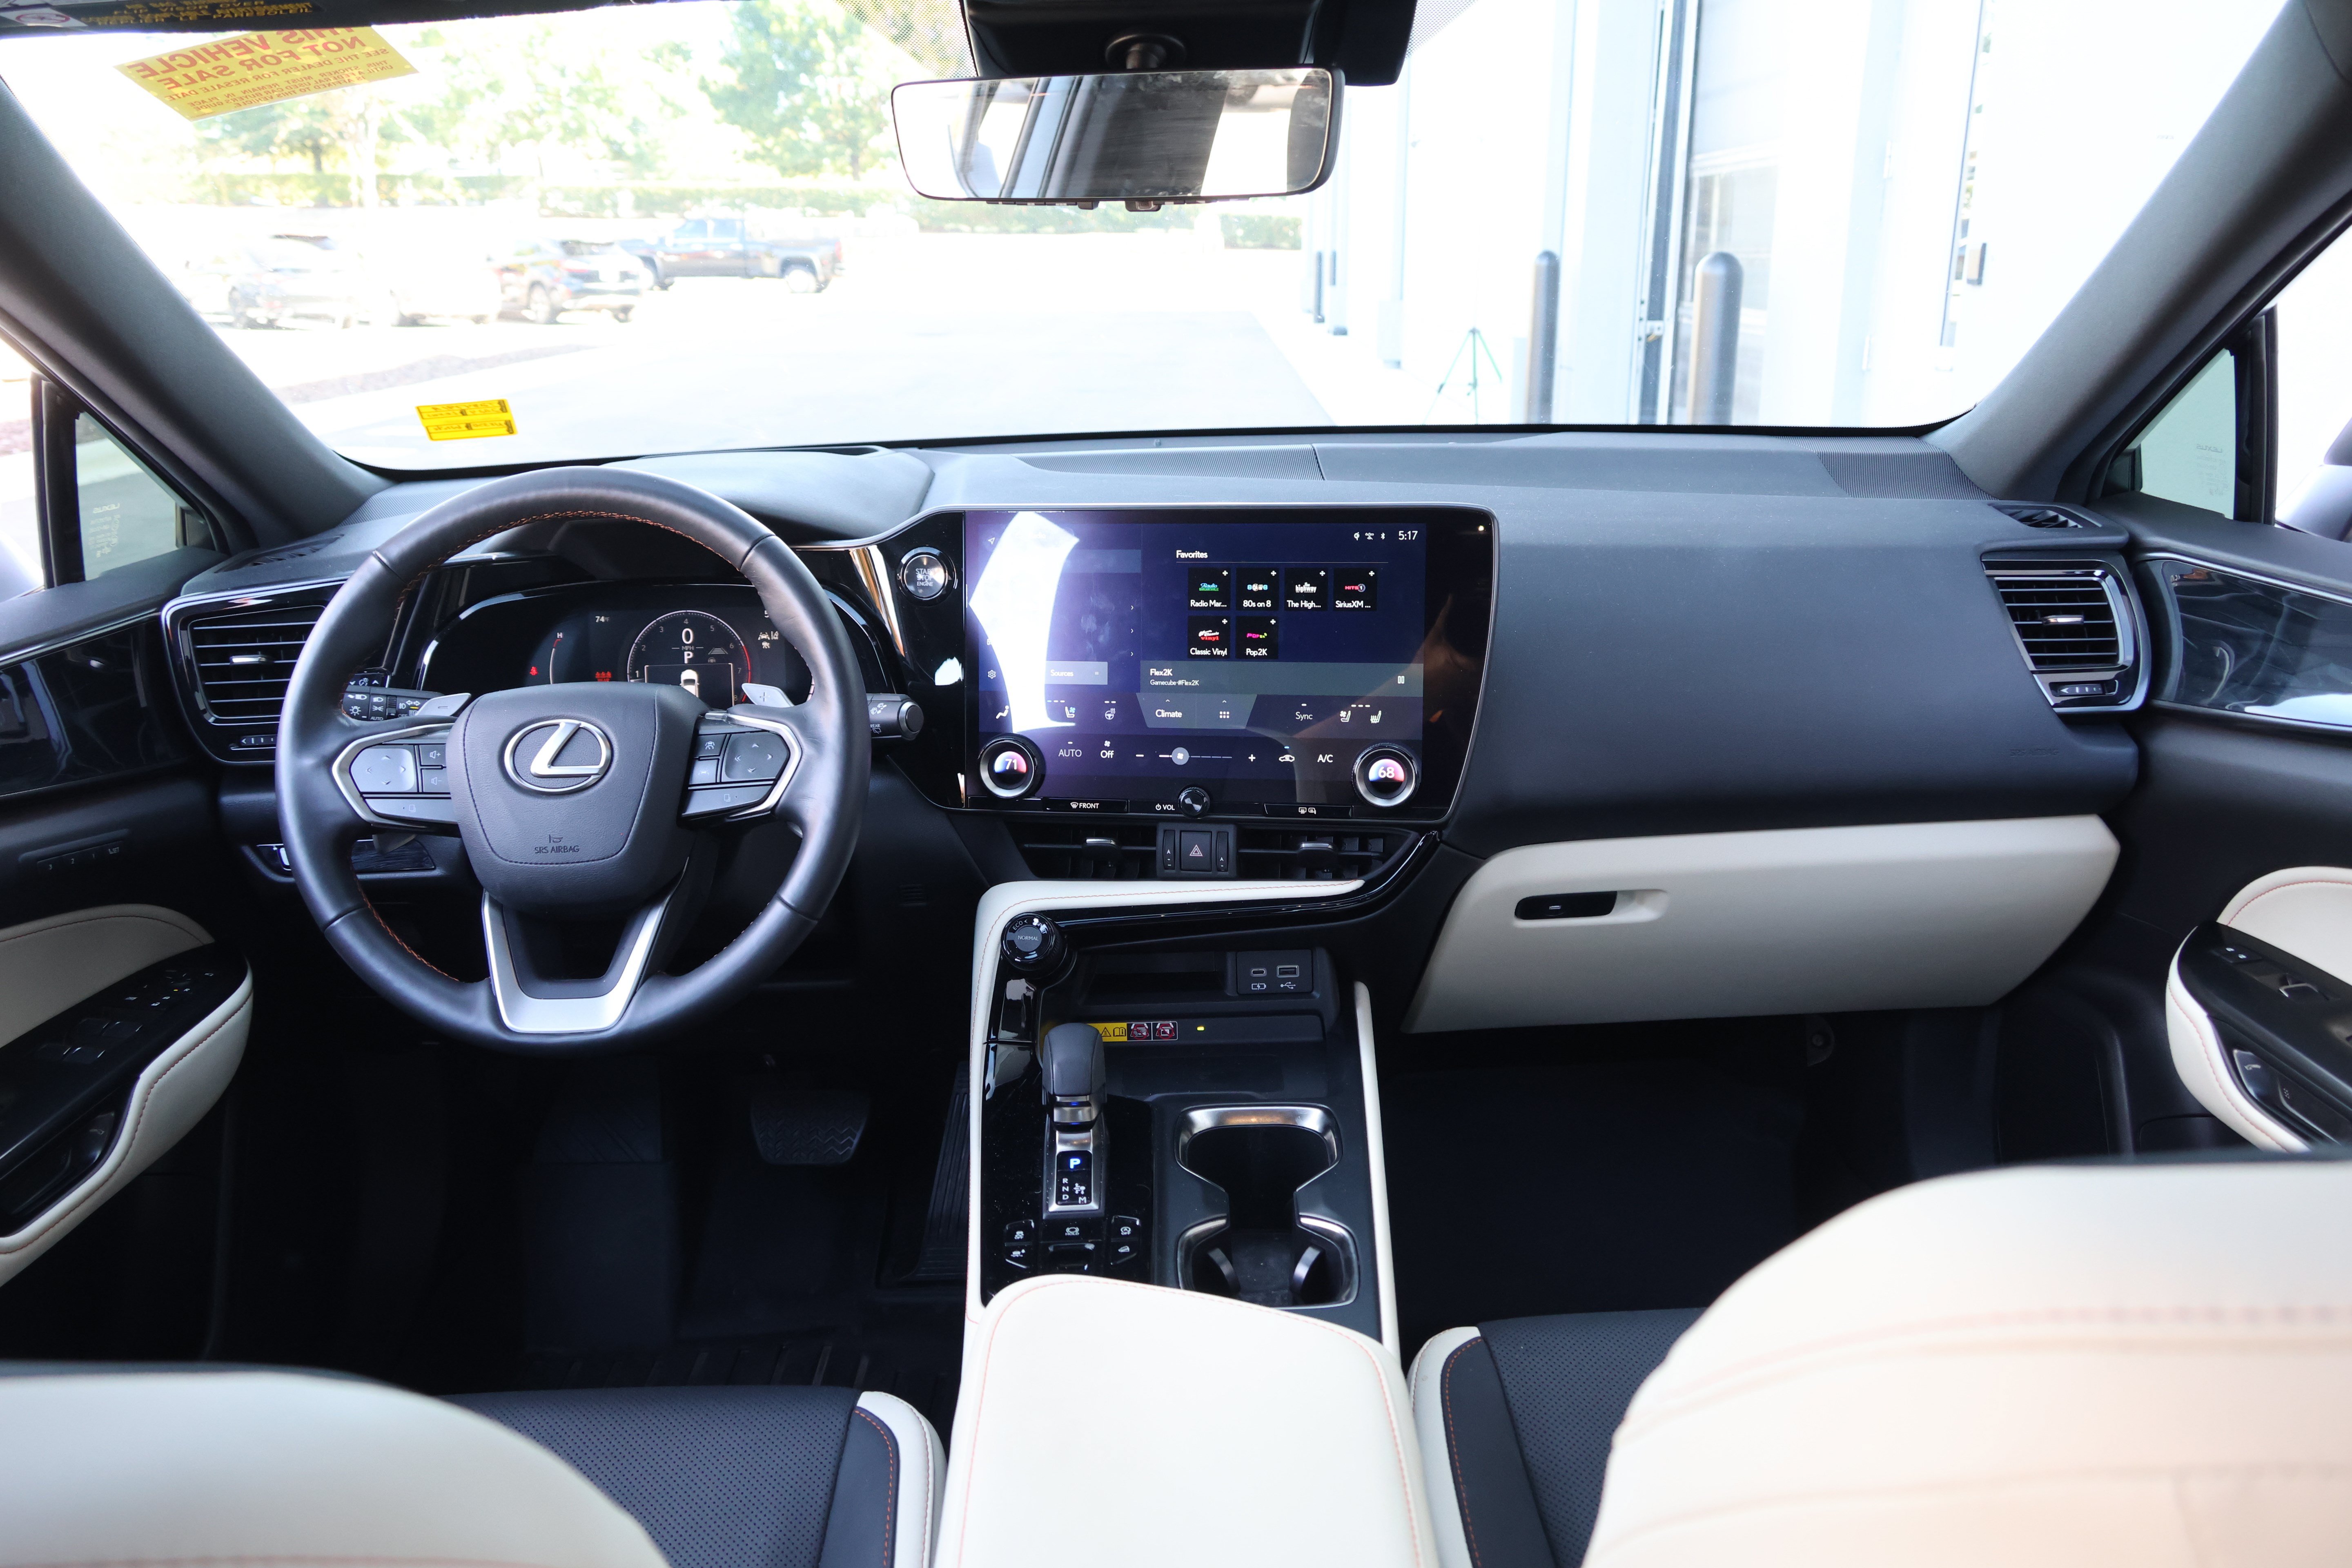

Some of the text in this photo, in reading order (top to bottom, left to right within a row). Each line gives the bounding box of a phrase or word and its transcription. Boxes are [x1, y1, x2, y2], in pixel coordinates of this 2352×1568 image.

[1398, 530, 1418, 540] 5:17
[1176, 550, 1208, 558] Favorites
[1295, 584, 1317, 593] highway
[1301, 600, 1321, 609] High...
[682, 628, 694, 644] 0
[1212, 648, 1227, 657] Vinyl
[1246, 648, 1267, 657] Pop2K
[684, 651, 693, 664] P
[1155, 709, 1183, 718] Climate
[1295, 712, 1313, 721] Sync
[1058, 749, 1082, 757] AUTO
[1100, 750, 1114, 758] Off
[1317, 754, 1334, 763] A/C
[1005, 759, 1017, 770] 71
[1378, 766, 1395, 778] 68
[534, 845, 580, 854] SRS AIRBAG
[1013, 920, 1023, 930] ECO
[1070, 1158, 1081, 1169] P
